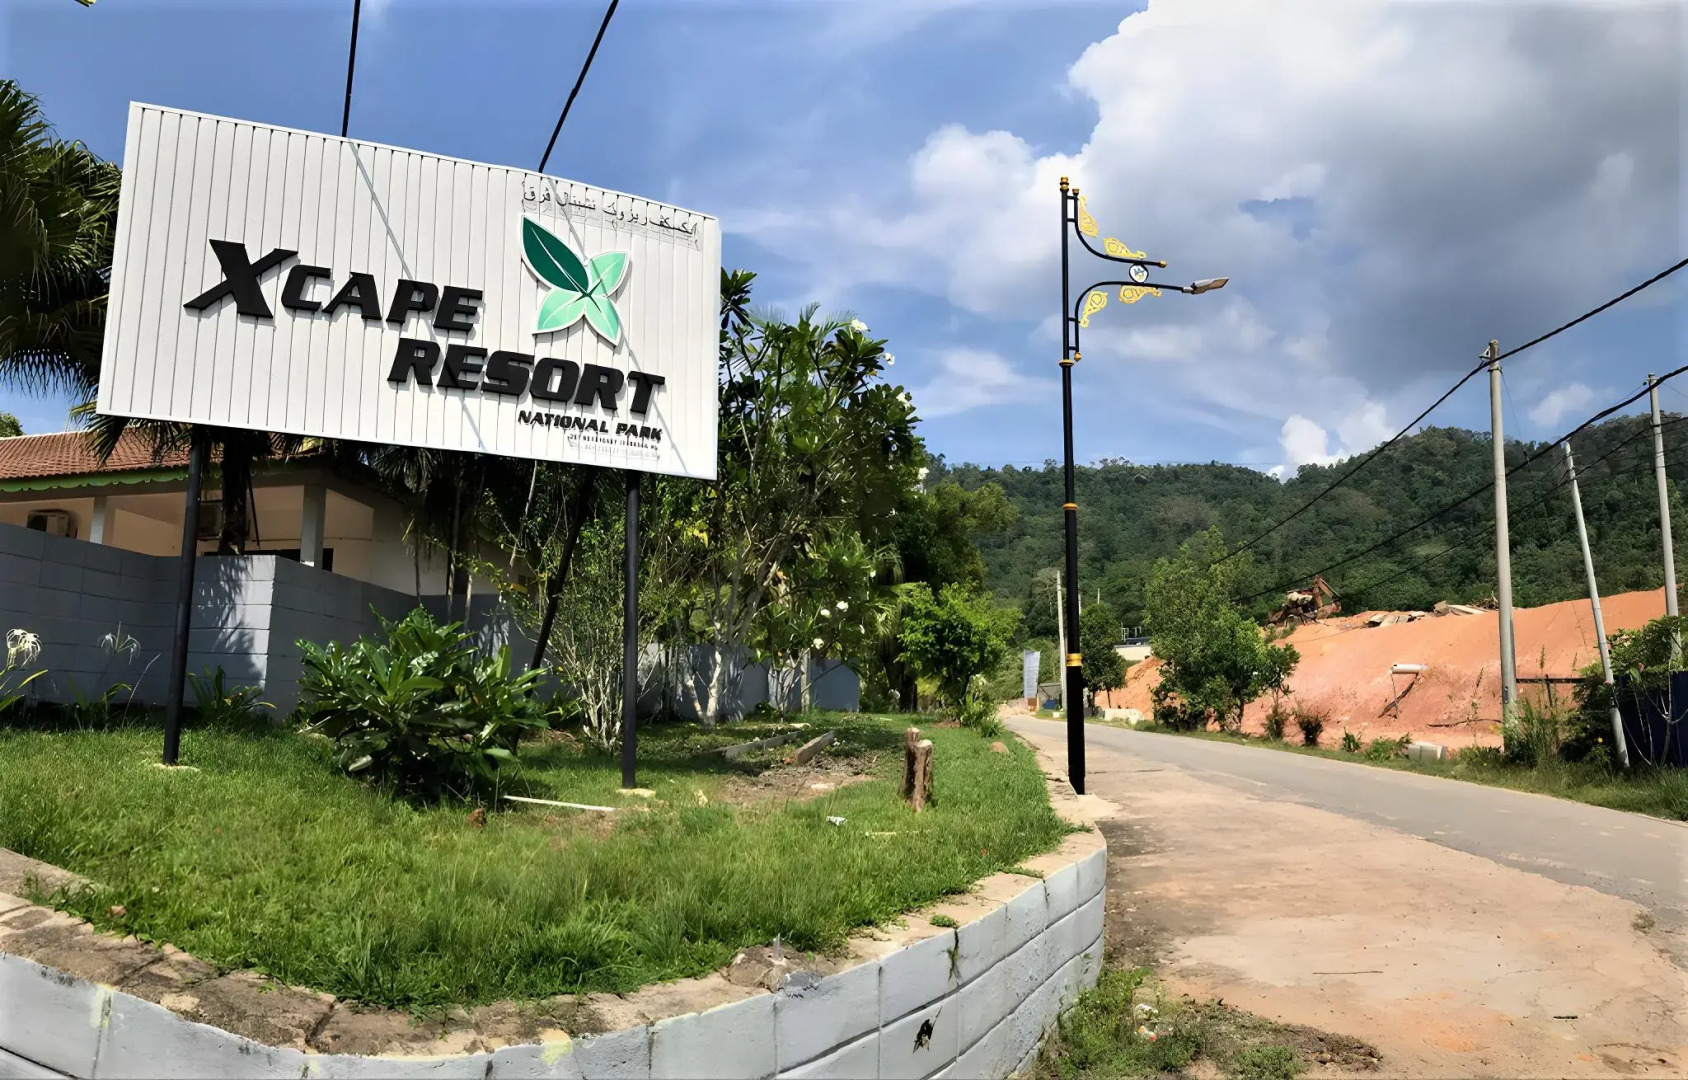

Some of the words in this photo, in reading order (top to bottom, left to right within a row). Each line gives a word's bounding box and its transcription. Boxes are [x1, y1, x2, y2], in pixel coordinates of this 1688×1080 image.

[183, 238, 484, 332] XCAPE
[387, 337, 666, 415] RESORT
[517, 409, 609, 434] NATIONAL
[615, 422, 663, 442] PARK
